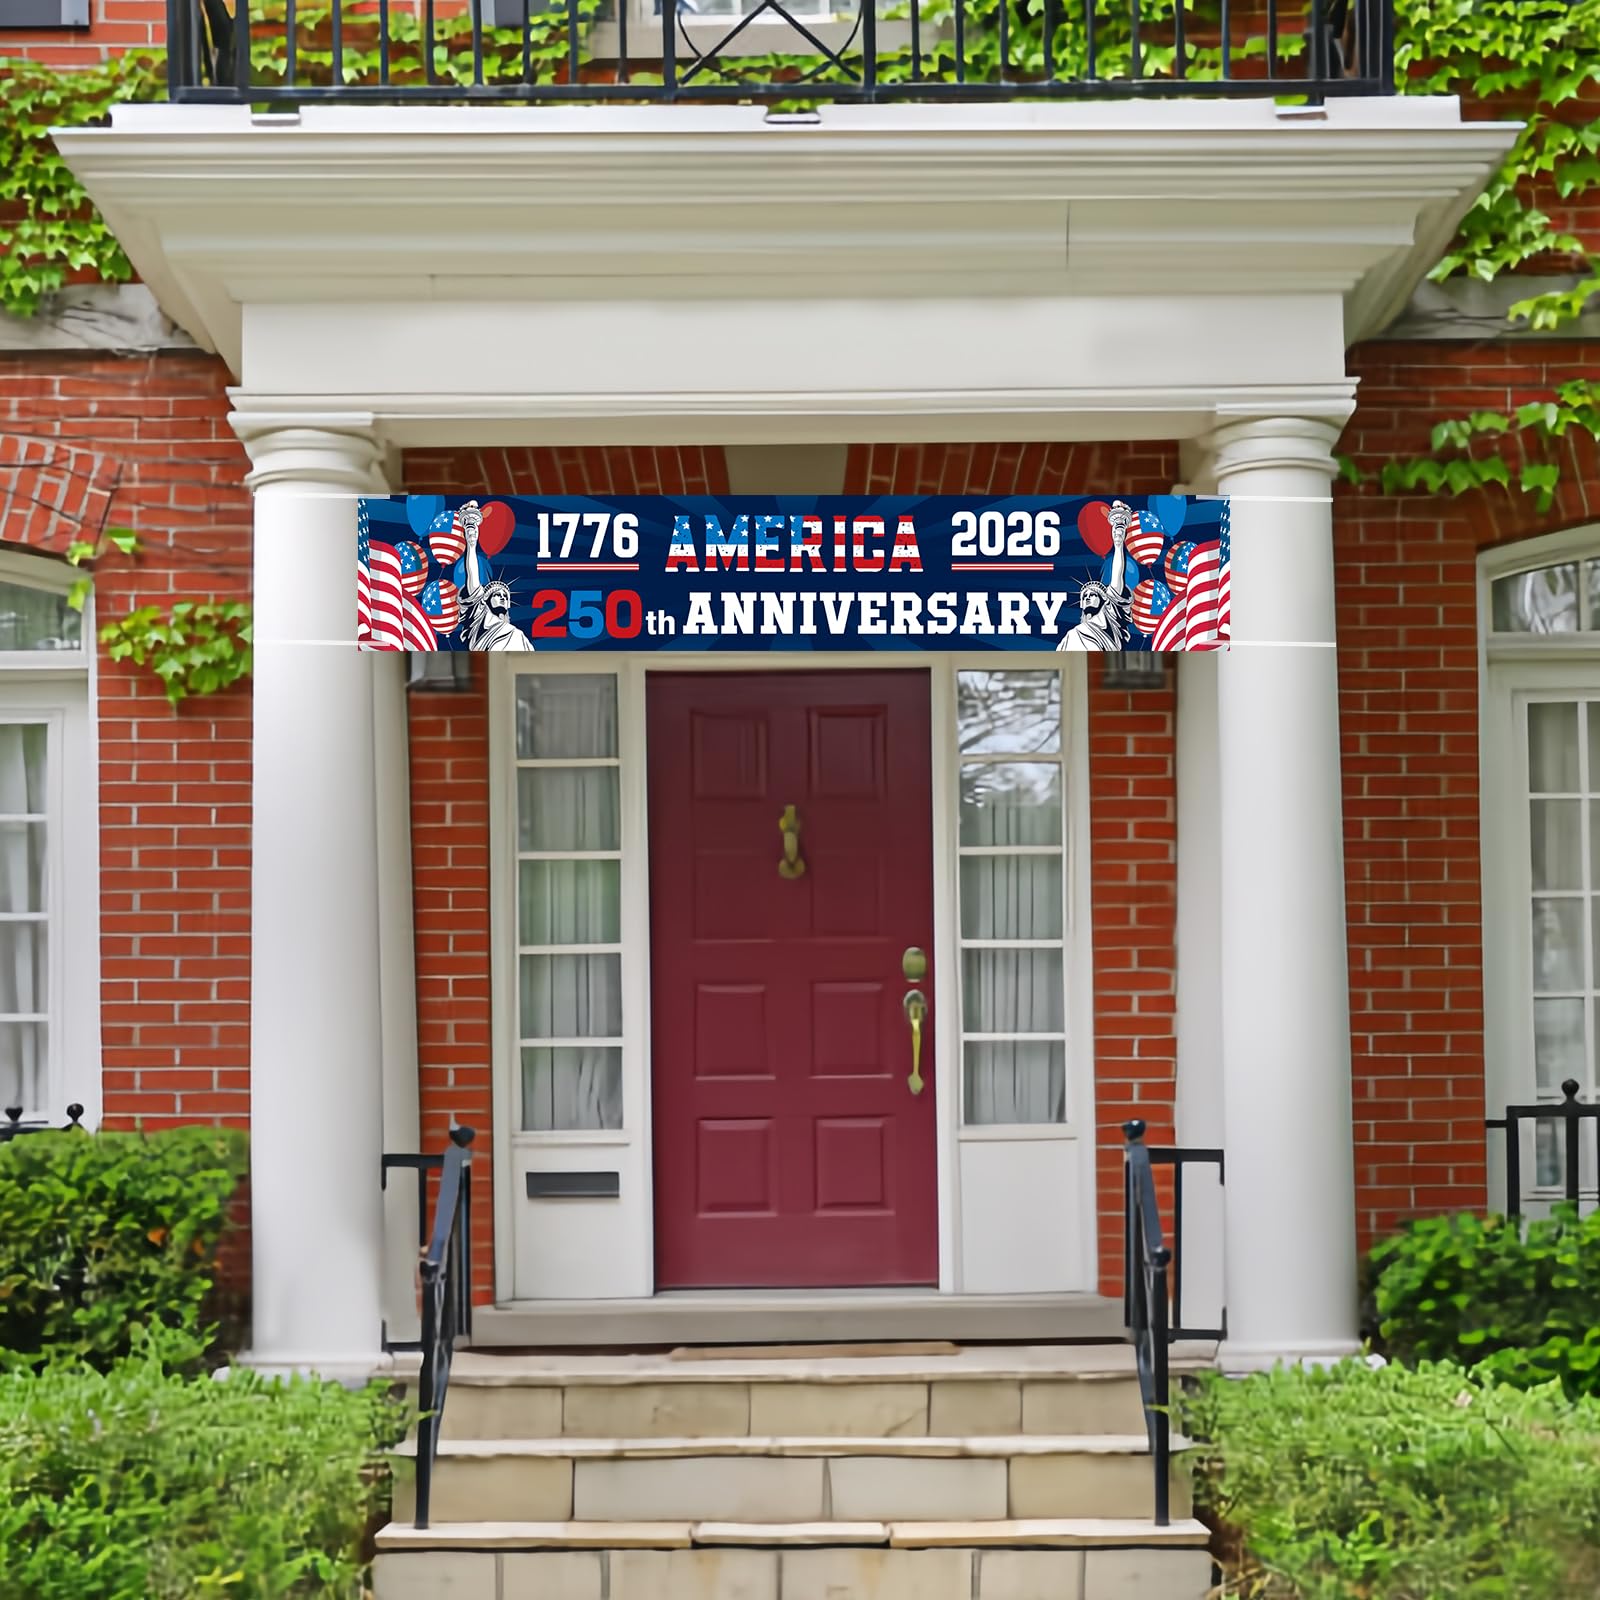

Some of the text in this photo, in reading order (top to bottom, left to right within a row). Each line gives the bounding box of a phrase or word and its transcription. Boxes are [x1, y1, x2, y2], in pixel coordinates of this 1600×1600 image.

[536, 510, 1061, 573] 1776 AMERICA 2026
[682, 591, 1067, 636] ANNIVERSARY
